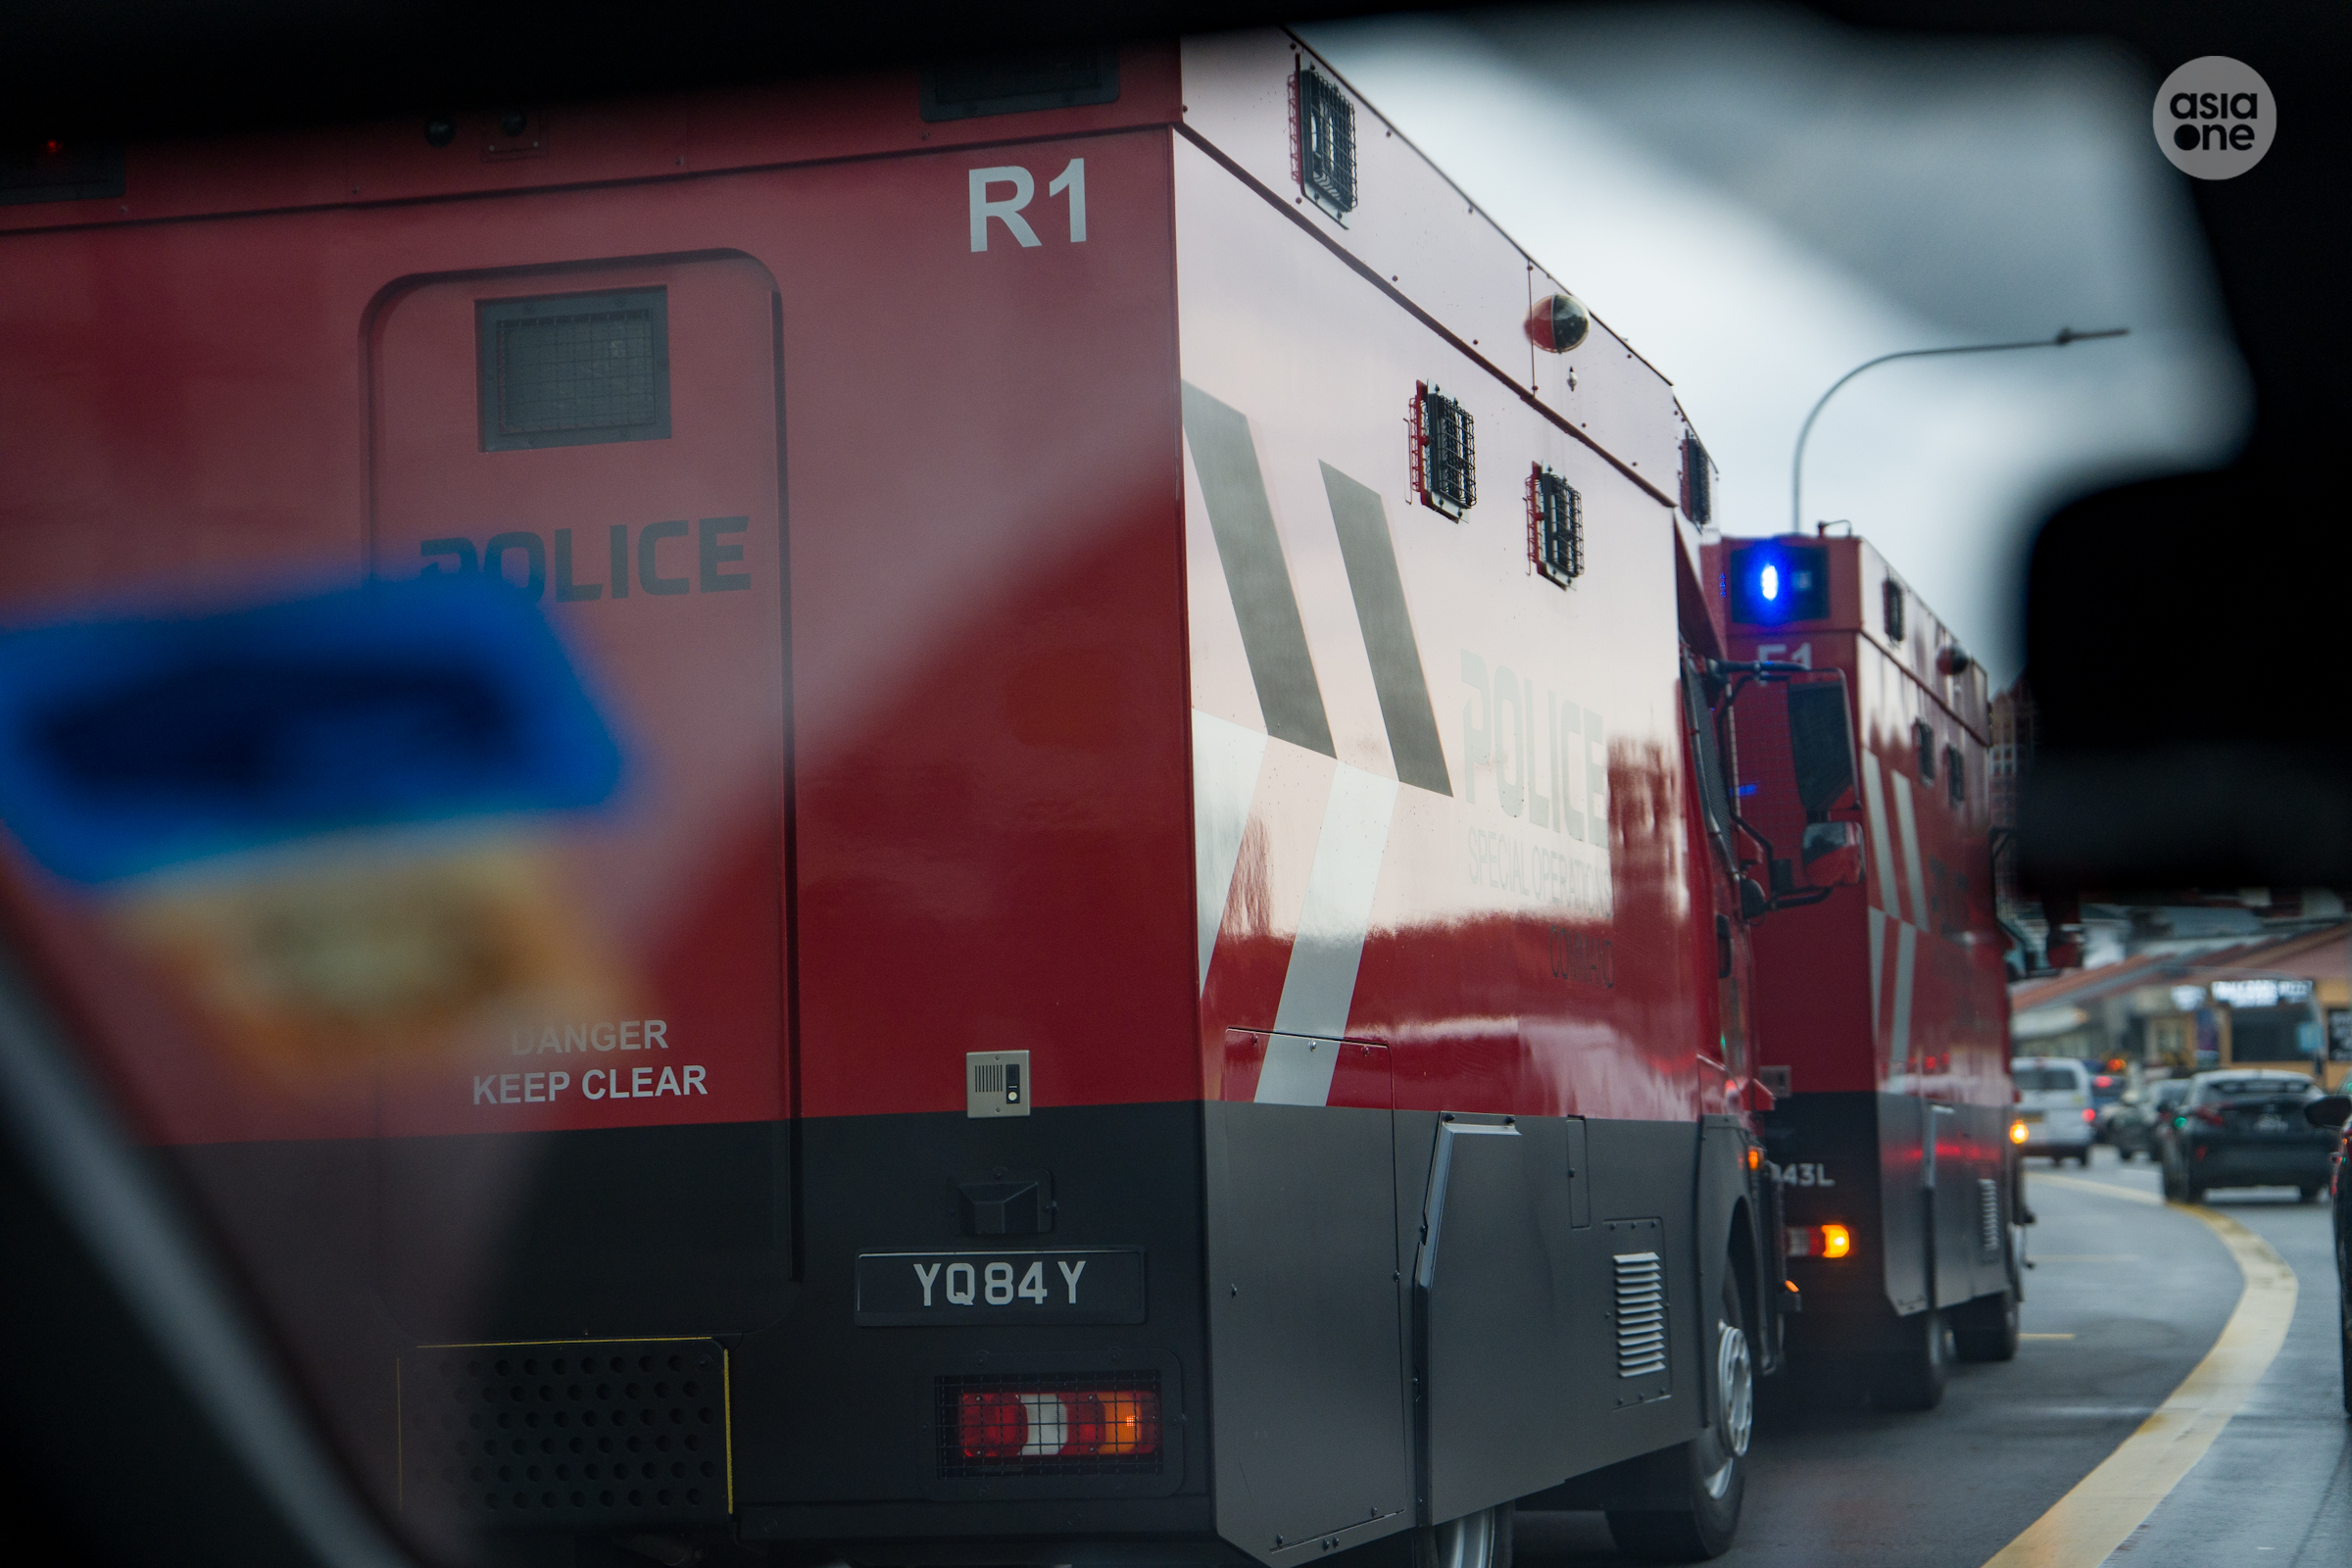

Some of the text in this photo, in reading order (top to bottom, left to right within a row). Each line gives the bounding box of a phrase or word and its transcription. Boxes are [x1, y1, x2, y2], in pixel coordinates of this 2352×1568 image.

[968, 157, 1087, 253] R1
[1460, 648, 1610, 851] POLICE
[1468, 825, 1614, 919] SPECIAL OPERATIONS
[1549, 924, 1615, 989] COMMAND
[511, 1019, 669, 1056] DANGER
[473, 1064, 708, 1105] KEEP CLEAR
